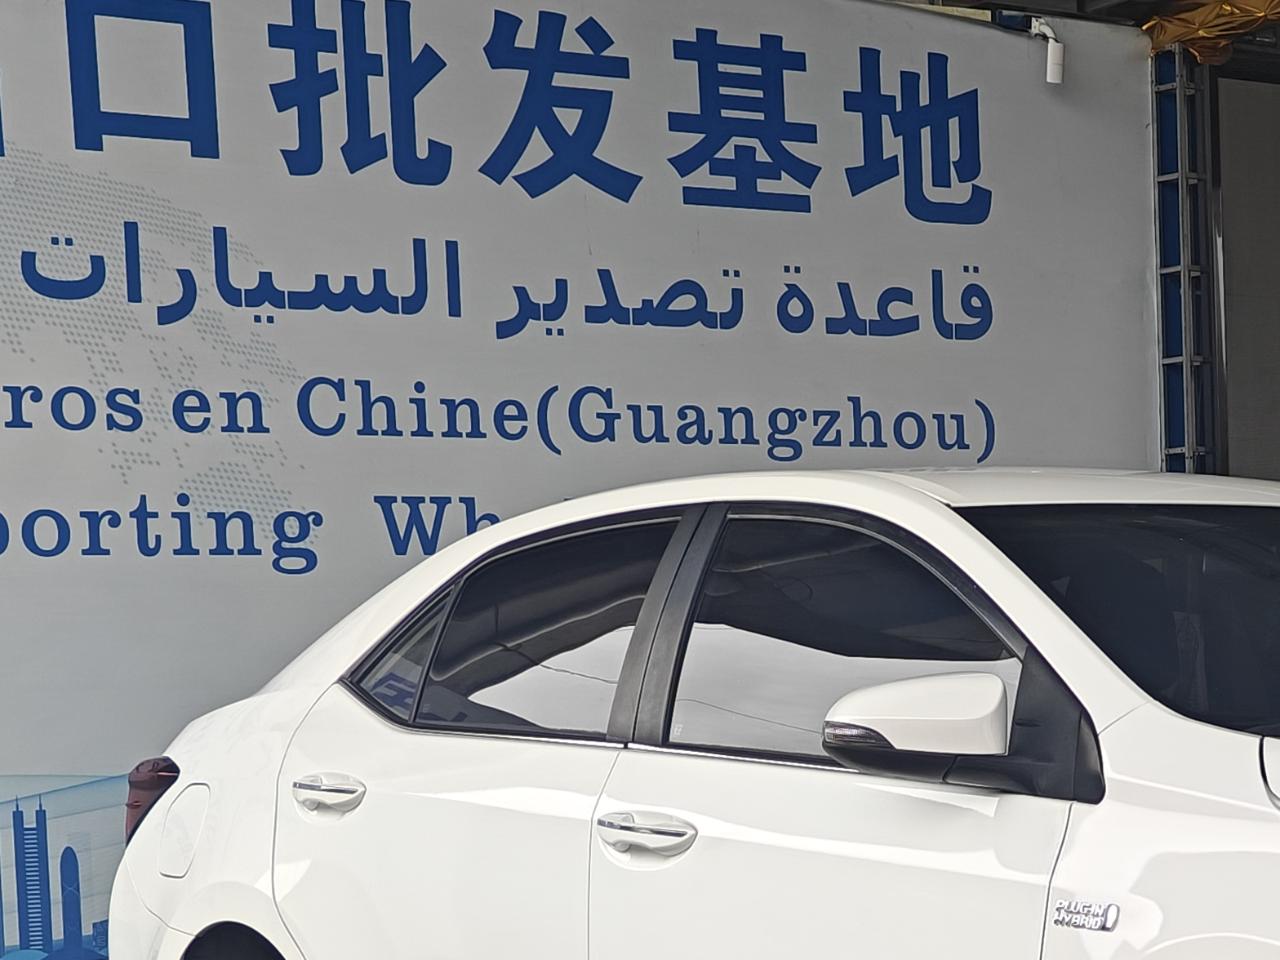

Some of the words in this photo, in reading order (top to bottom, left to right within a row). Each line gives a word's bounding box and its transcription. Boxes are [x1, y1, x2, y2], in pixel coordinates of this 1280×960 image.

[0, 0, 993, 226] 口批发基地
[20, 221, 461, 326] السيارات
[495, 268, 745, 340] تصدير
[776, 265, 994, 340] قاعدة
[2, 385, 144, 432] ros
[172, 388, 270, 434] en
[297, 376, 997, 463] Chine(Guangzhou)
[0, 492, 323, 575] orting
[373, 495, 502, 556] Wh
